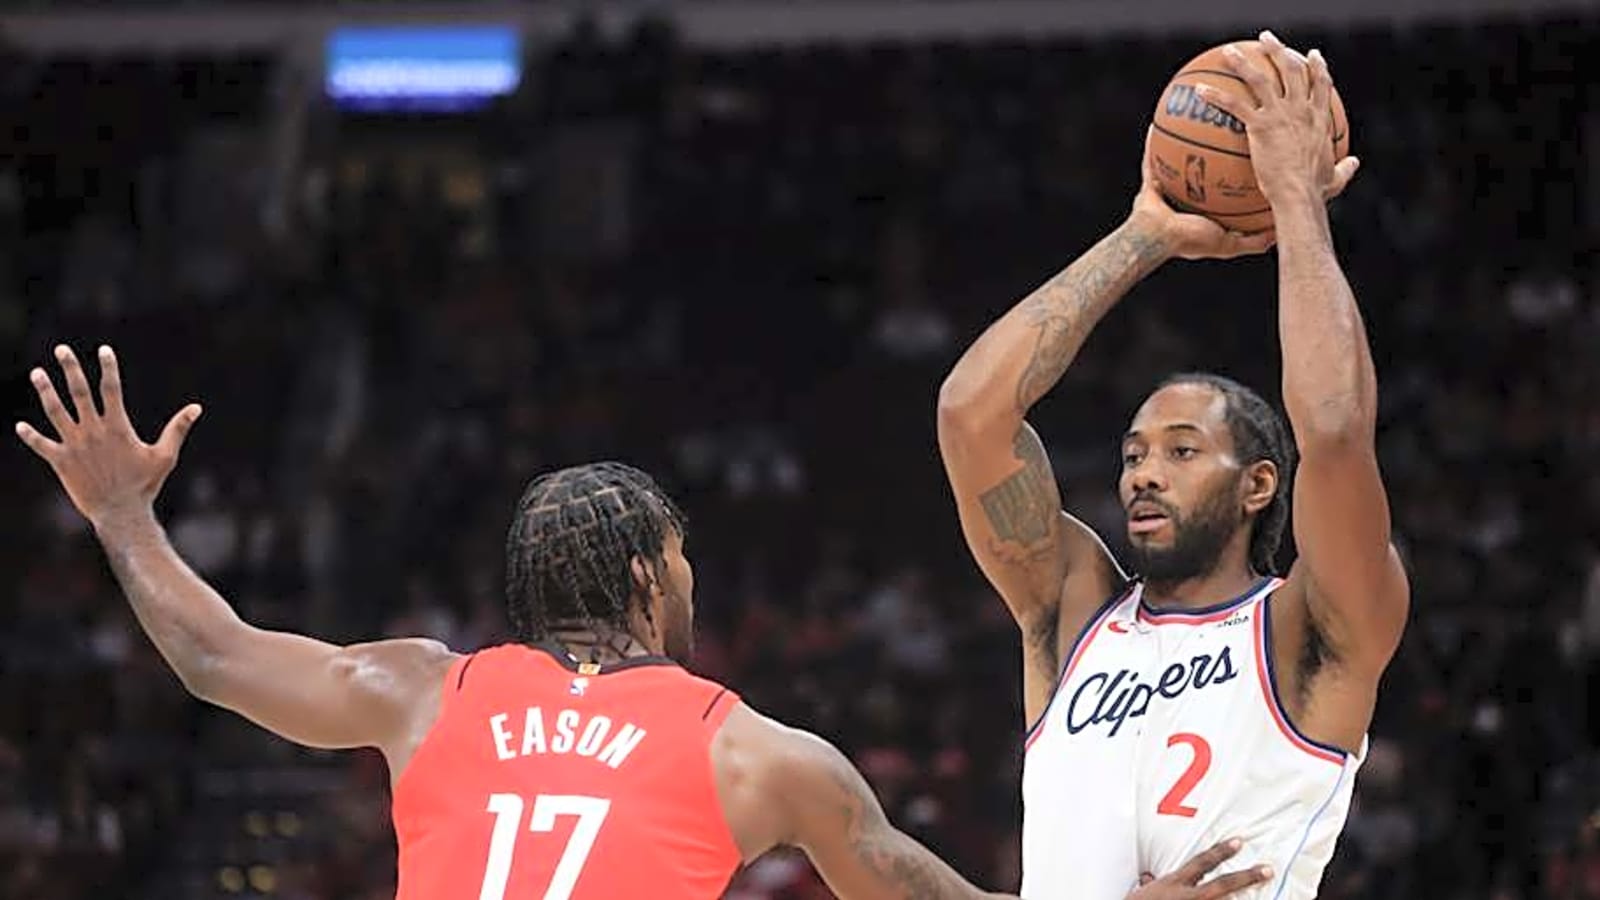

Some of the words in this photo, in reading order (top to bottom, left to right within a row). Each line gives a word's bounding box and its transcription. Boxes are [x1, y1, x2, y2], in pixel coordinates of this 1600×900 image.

[489, 706, 647, 769] EASON
[1156, 733, 1213, 818] 2
[479, 793, 612, 900] 17
